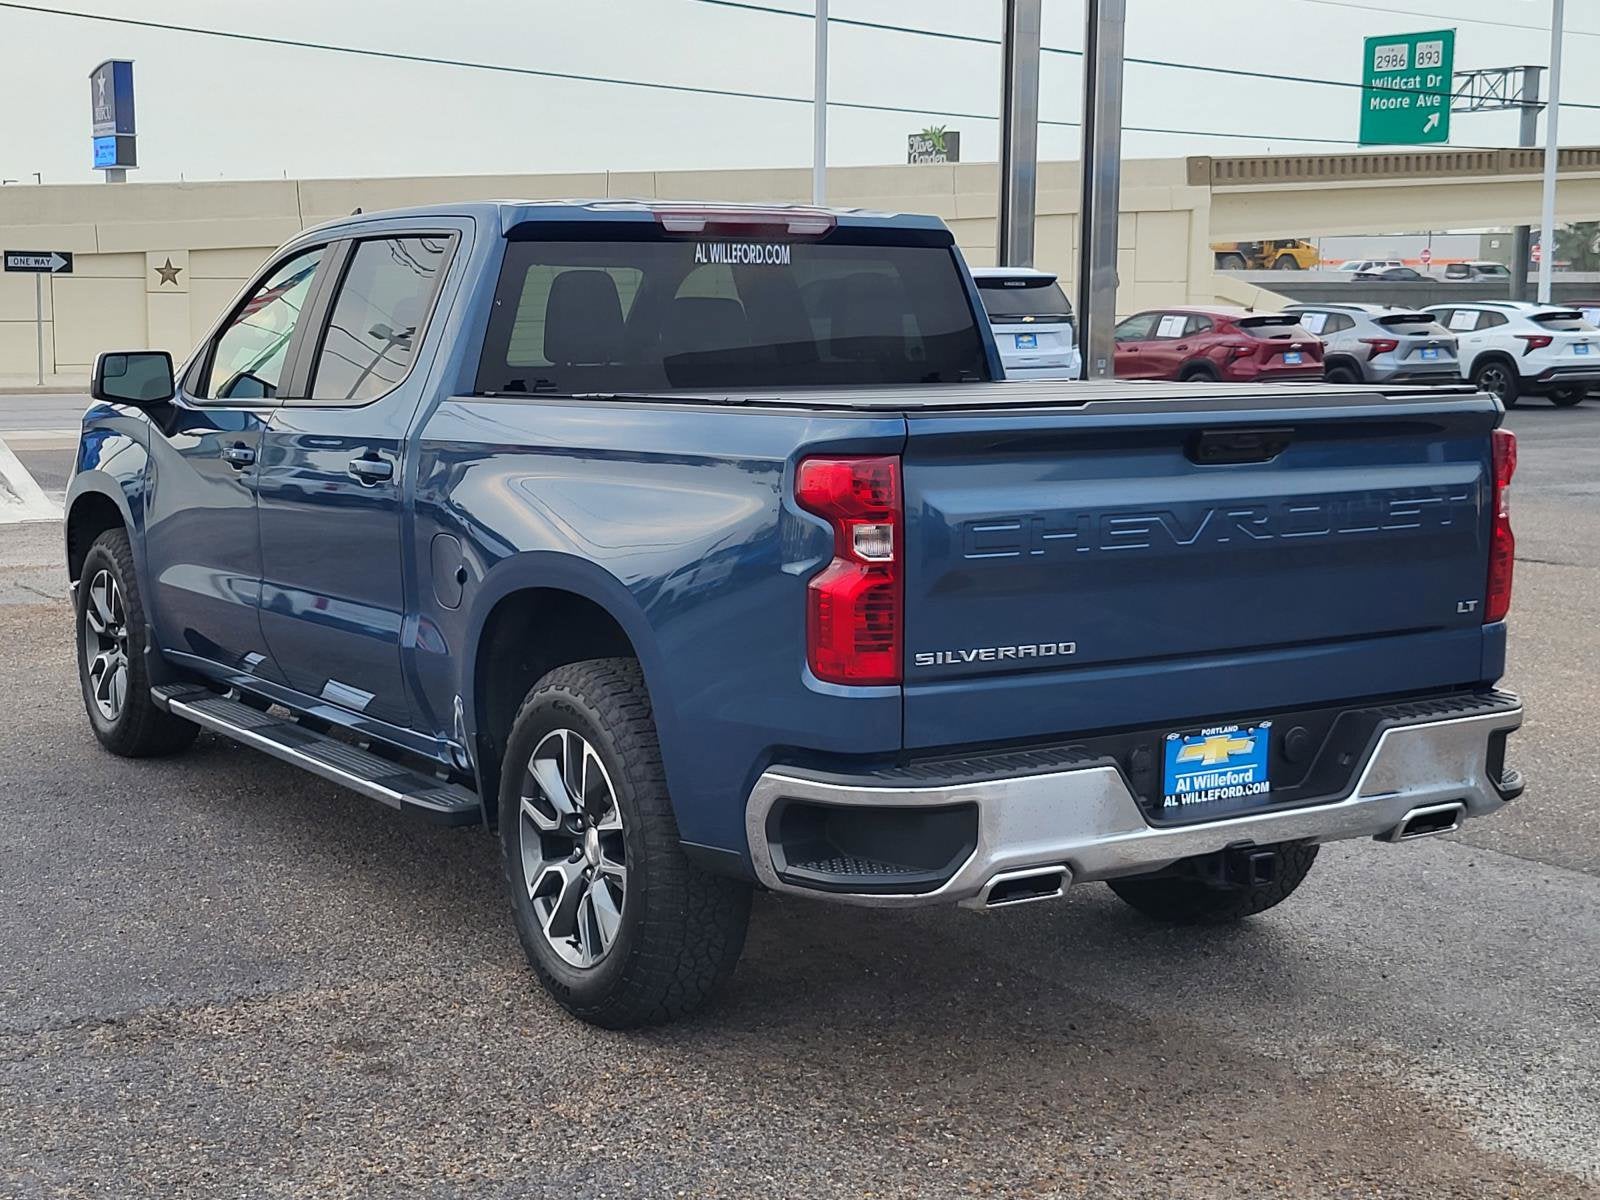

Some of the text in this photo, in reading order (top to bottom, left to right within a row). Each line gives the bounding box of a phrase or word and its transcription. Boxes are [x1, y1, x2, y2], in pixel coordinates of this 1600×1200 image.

[1376, 54, 1405, 68] 2986
[1417, 51, 1440, 65] 893
[1372, 75, 1442, 91] Wildcat Dr
[1370, 93, 1441, 109] Moore Ave
[909, 137, 933, 153] Olive
[13, 257, 51, 266] ONE WAY
[695, 243, 791, 265] AL WILLEFORD.COM
[963, 495, 1468, 559] CHEVROLET
[1457, 600, 1479, 613] LT
[915, 642, 1076, 666] SILVERADO
[1201, 725, 1239, 736] PORTLAND
[1175, 768, 1253, 793] Al Willeford
[1163, 781, 1270, 808] AL WILLEFORD.COM
